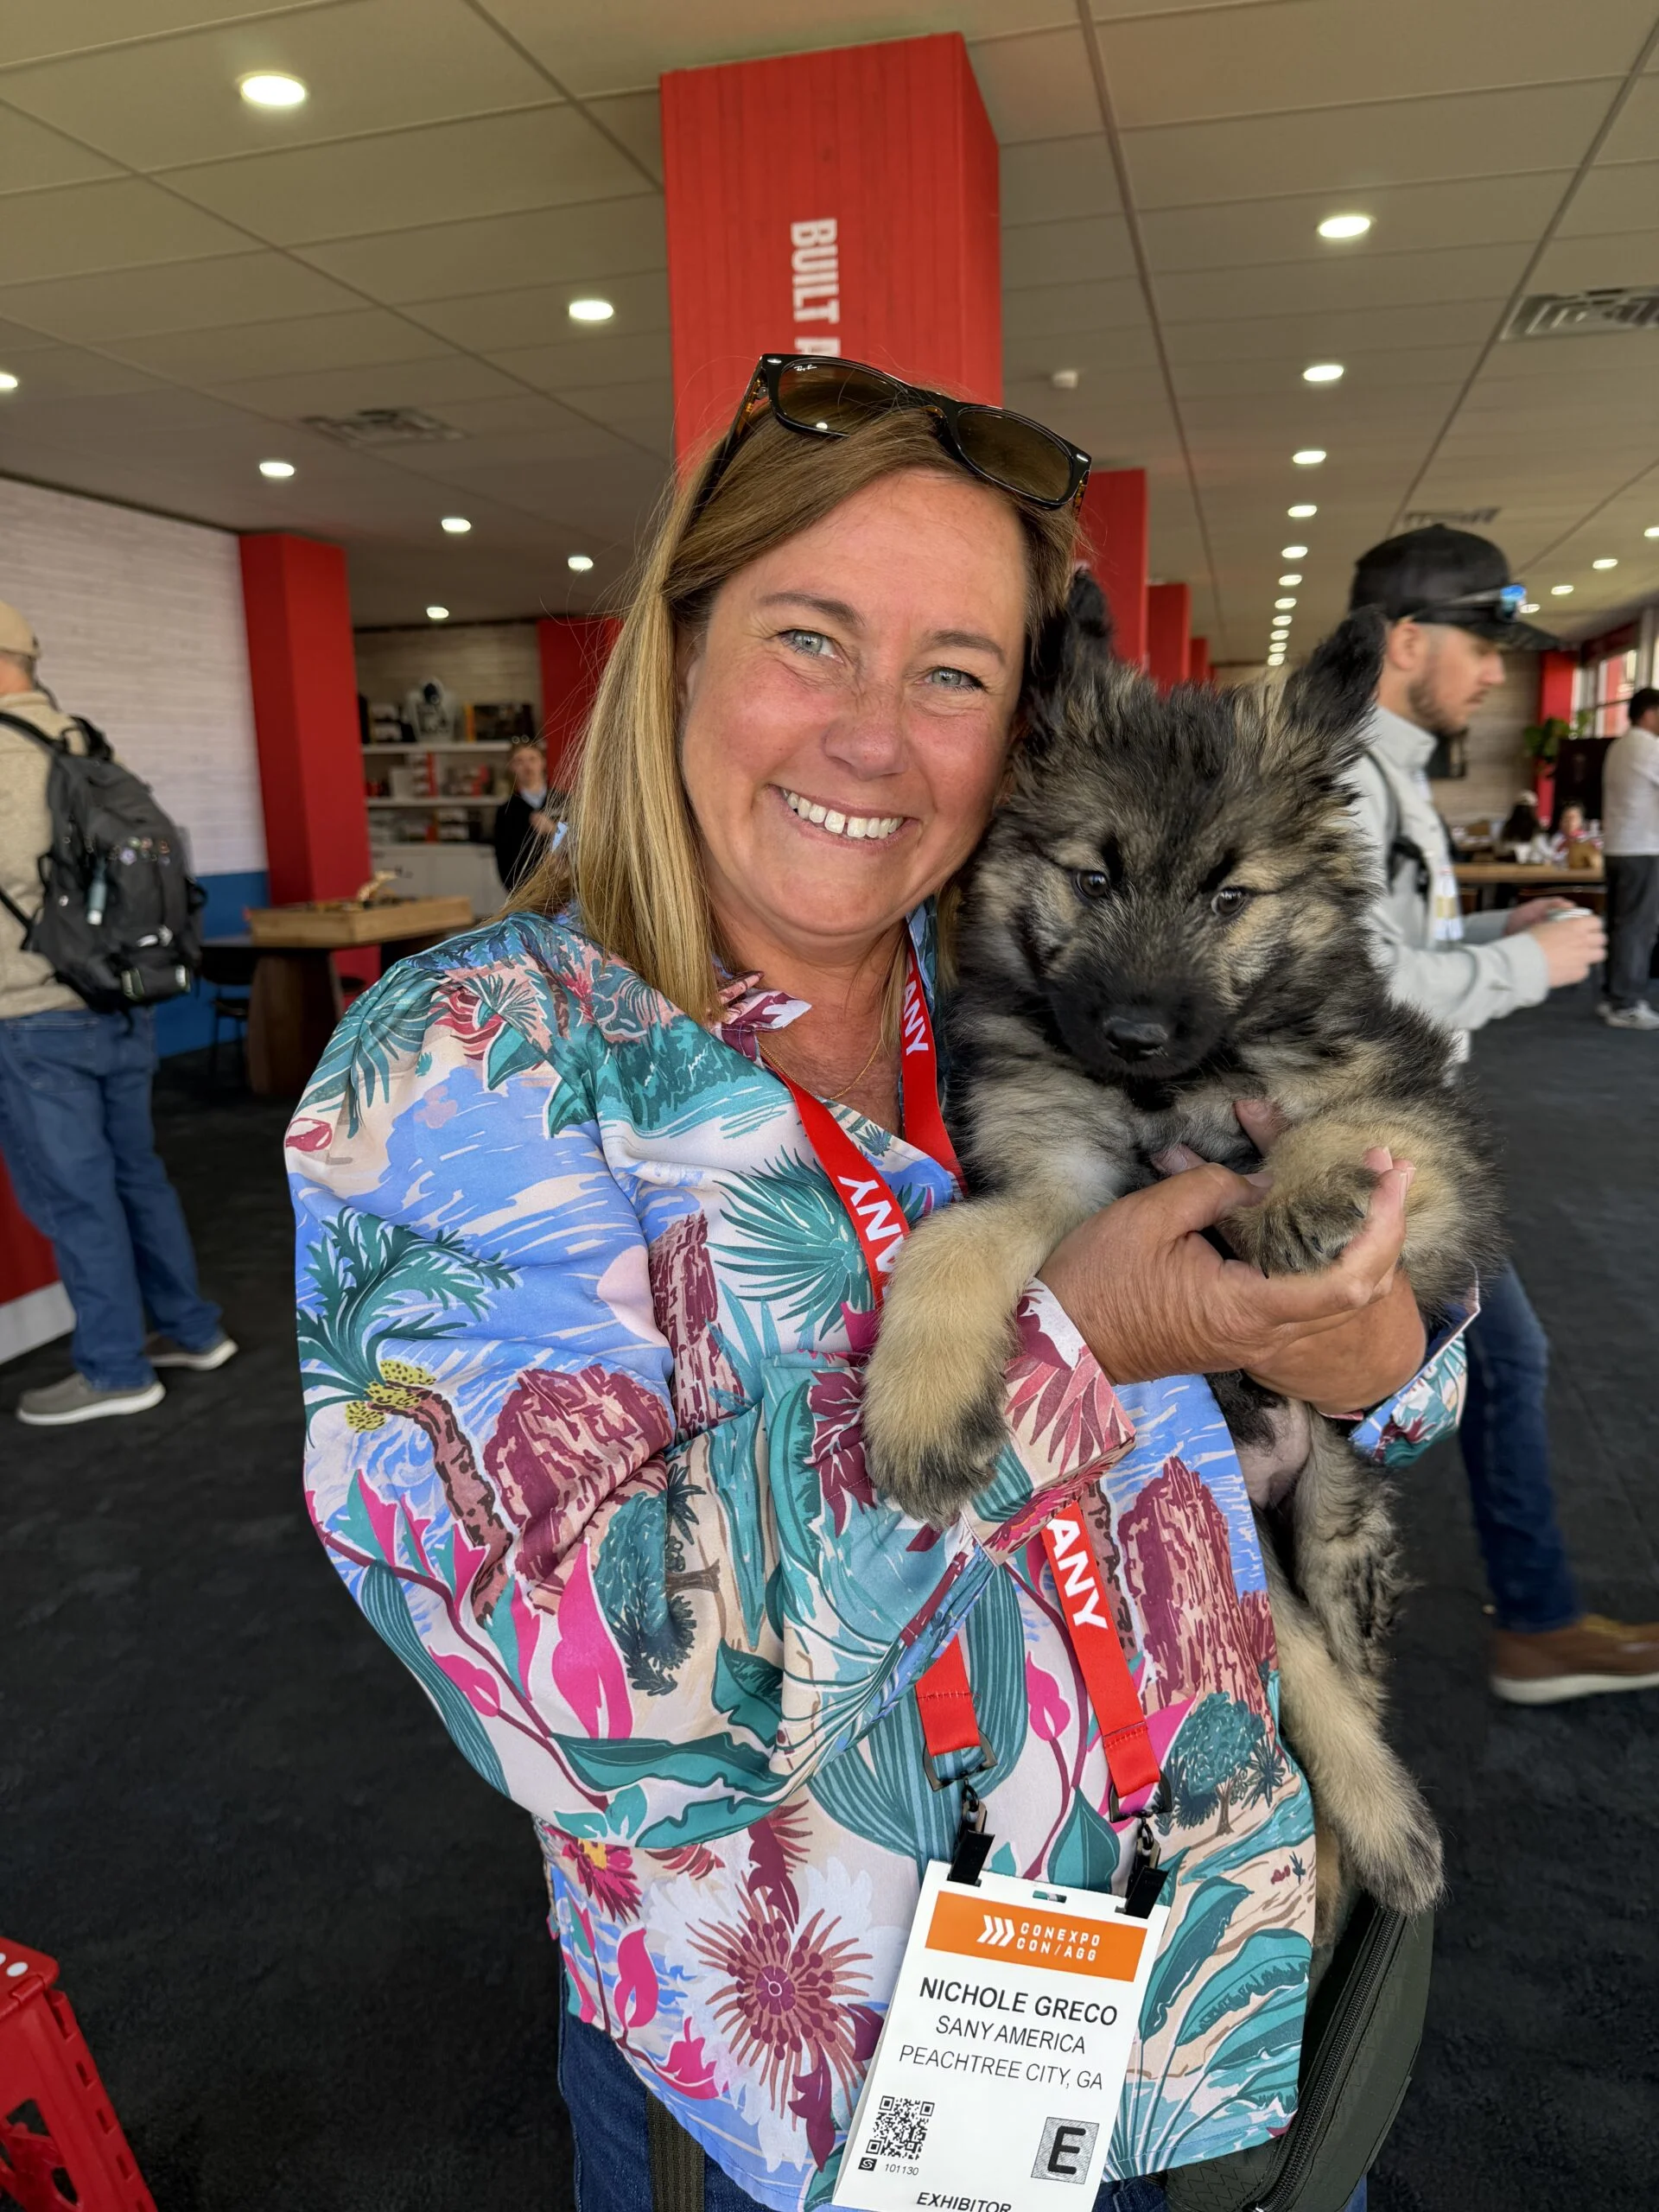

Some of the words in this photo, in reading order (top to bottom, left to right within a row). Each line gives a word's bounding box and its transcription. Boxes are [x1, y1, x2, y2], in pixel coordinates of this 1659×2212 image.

[791, 219, 840, 323] BUILT
[837, 1176, 904, 1287] ANY
[1046, 1518, 1109, 1630] ANY
[1016, 1936, 1097, 1961] CON/AGG
[1020, 1922, 1101, 1947] CONEXPO
[919, 1977, 1029, 2013] NICHOLE
[1034, 1999, 1117, 2026] GRECO
[936, 2015, 995, 2039] SANY
[994, 2024, 1085, 2054] AMERICA
[899, 2044, 1021, 2079] PEACHTREE
[1026, 2064, 1071, 2089] CITY,
[1077, 2069, 1103, 2090] GA
[885, 2163, 919, 2176] 101130
[1047, 2126, 1086, 2174] E
[916, 2192, 1012, 2212] EXHIBITOR
